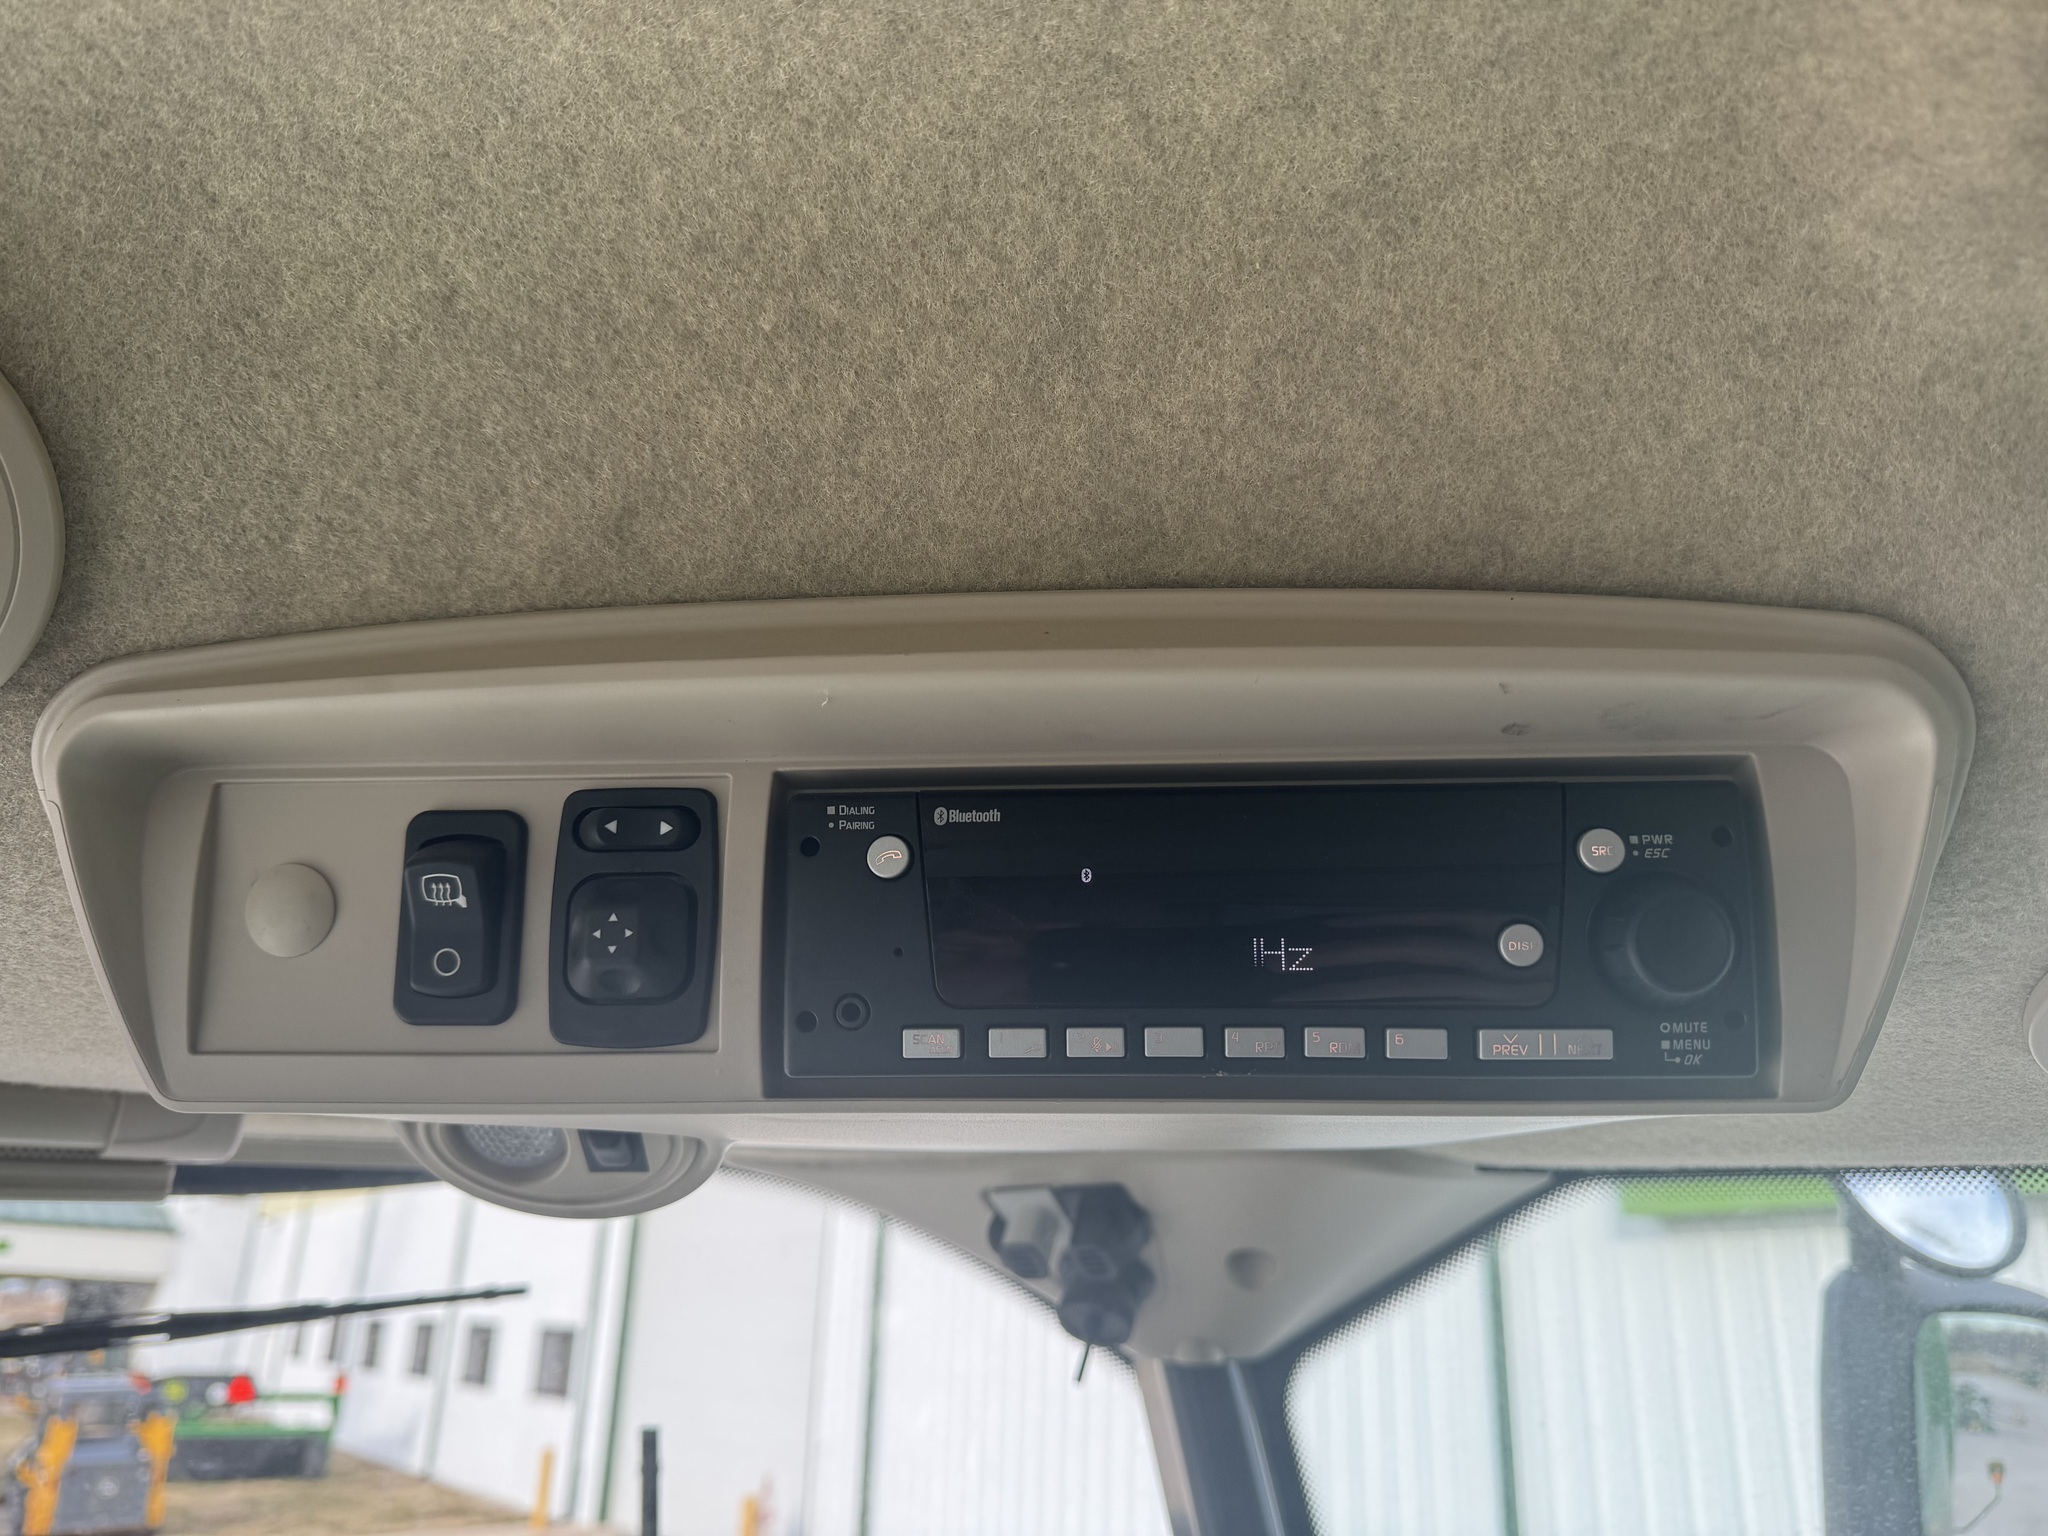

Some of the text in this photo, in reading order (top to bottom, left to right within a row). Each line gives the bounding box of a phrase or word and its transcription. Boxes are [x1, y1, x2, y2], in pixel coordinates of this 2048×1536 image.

[838, 805, 875, 816] DIALING
[949, 808, 1001, 823] Bluetooth
[838, 820, 875, 830] PAIRING
[1641, 834, 1673, 845] PWR
[1591, 845, 1614, 856] SRC
[1644, 848, 1670, 858] ESC
[1672, 1022, 1708, 1033] MUTE
[912, 1033, 945, 1045] SCAN
[1155, 1032, 1163, 1043] 3
[1231, 1031, 1239, 1042] 4
[1312, 1031, 1321, 1043] 5
[1394, 1033, 1404, 1045] 6
[1492, 1044, 1528, 1056] PREV
[1673, 1039, 1711, 1050] MENU
[1684, 1054, 1703, 1065] OK
